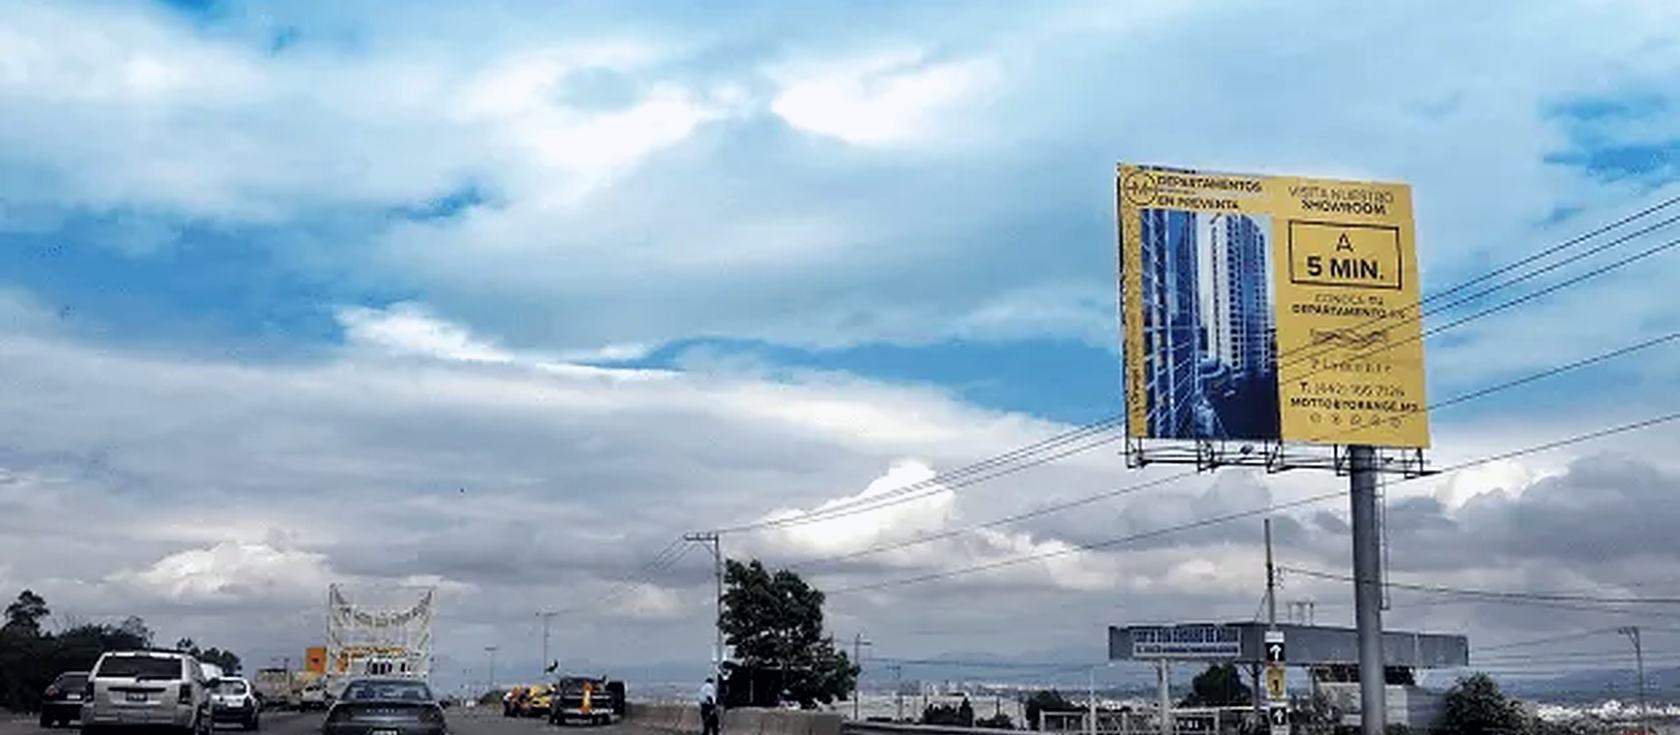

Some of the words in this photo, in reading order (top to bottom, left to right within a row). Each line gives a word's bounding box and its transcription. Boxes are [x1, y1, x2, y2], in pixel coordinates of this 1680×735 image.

[1157, 175, 1262, 192] DEPARTAMENTOS
[1157, 195, 1174, 206] EN
[1178, 197, 1239, 209] PREVENTA
[1288, 186, 1328, 199] VISITA
[1331, 189, 1394, 204] NUESTRO
[1301, 199, 1386, 214] SHOWROOM
[1336, 232, 1353, 252] A
[1307, 256, 1322, 276] 5
[1330, 258, 1384, 280] MIN.
[1291, 304, 1386, 318] DEPARTAMENTO
